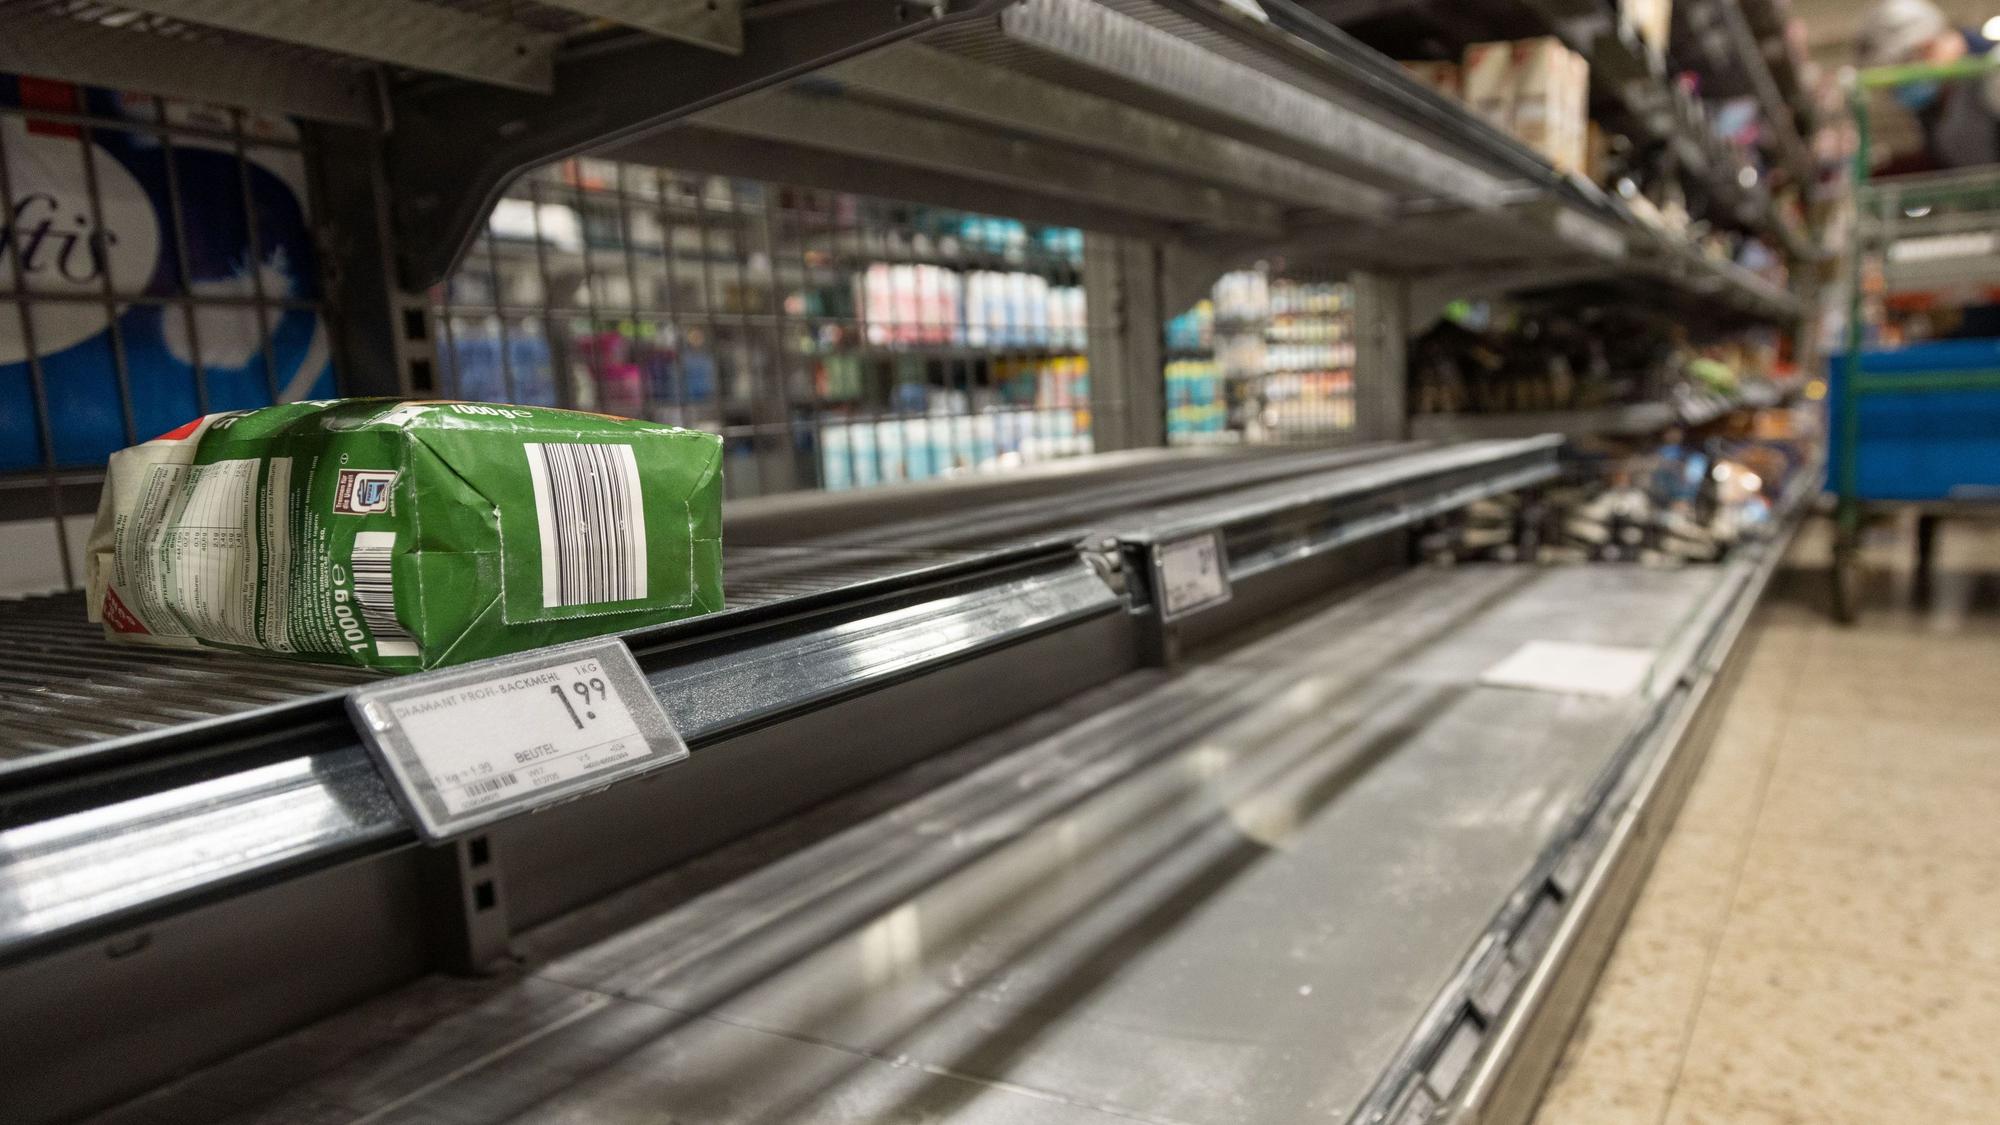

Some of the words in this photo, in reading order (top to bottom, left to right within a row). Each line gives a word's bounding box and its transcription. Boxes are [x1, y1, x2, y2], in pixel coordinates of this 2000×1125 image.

[335, 484, 346, 508] Trennen
[319, 593, 332, 631] ZENTRALE
[334, 605, 369, 653] 1000
[395, 694, 457, 719] DIAMANT
[459, 671, 561, 703] PROFI-BACKMEHL
[514, 743, 560, 764] BEUTEL
